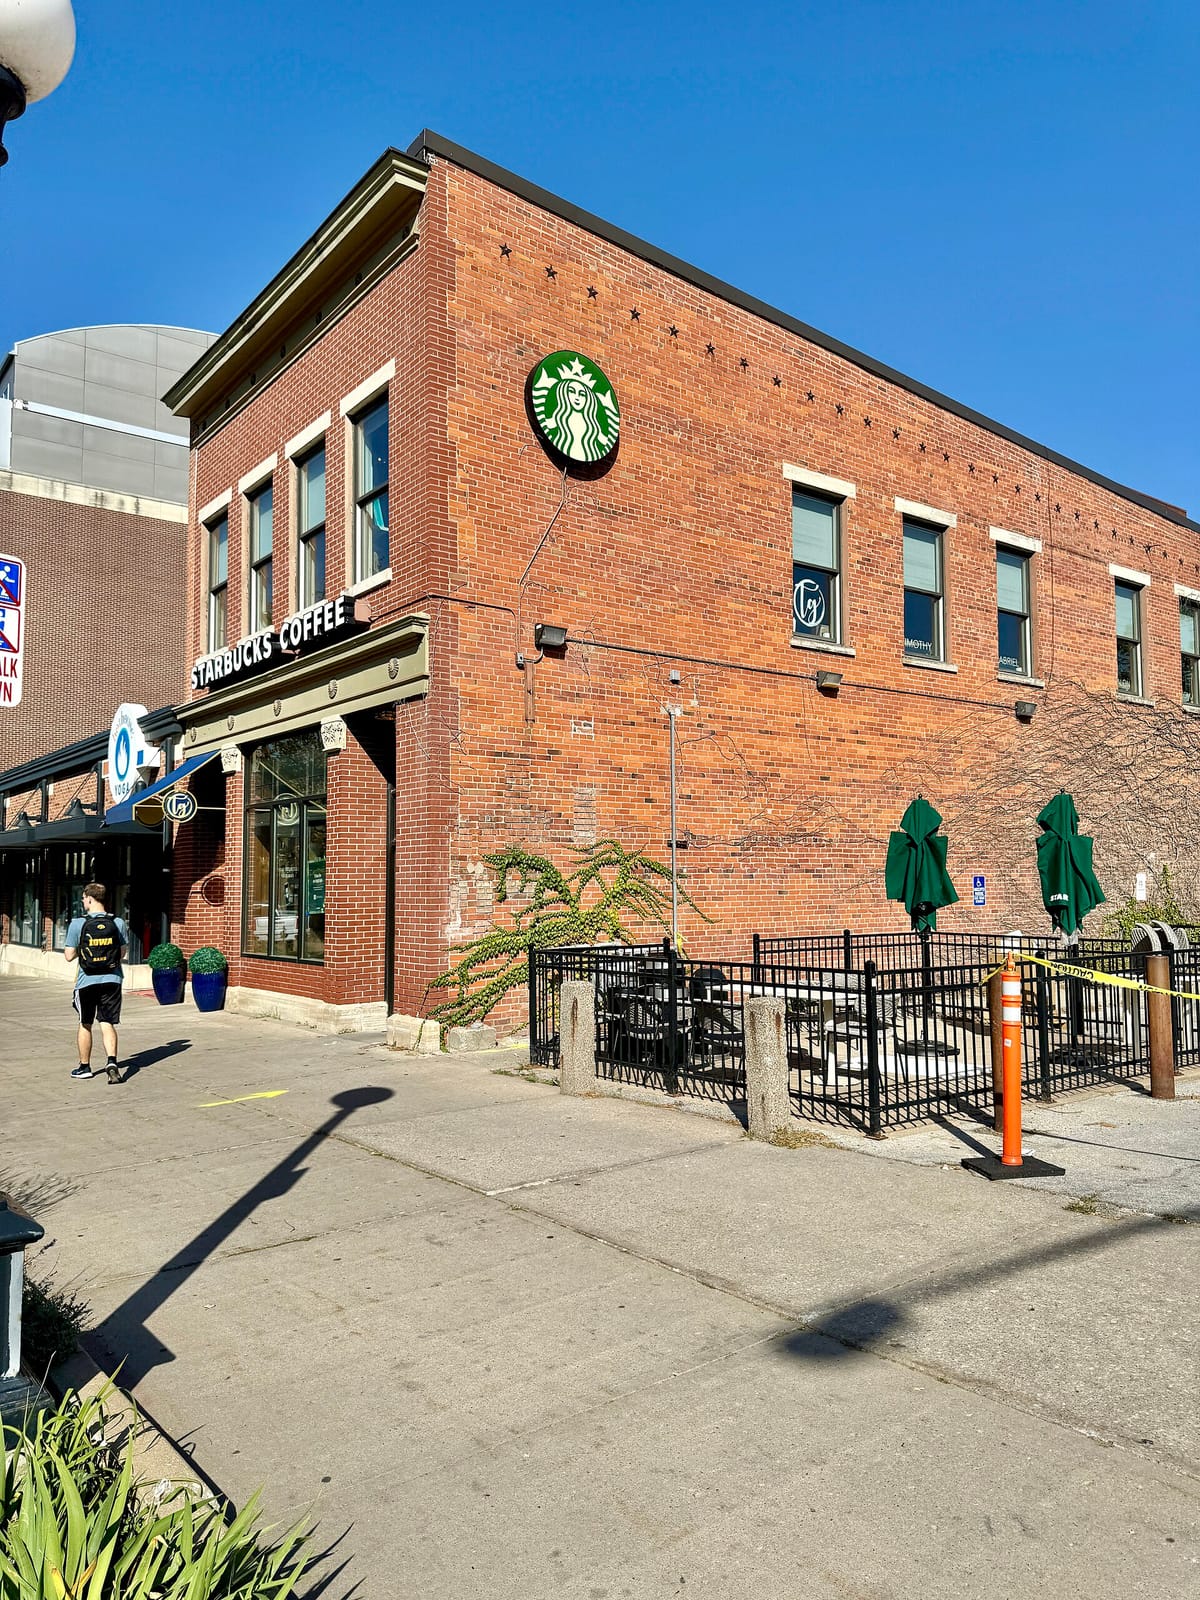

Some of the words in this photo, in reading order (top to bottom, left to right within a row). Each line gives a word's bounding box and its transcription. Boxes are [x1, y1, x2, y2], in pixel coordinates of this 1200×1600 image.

[191, 631, 272, 690] STARBUCKS
[279, 595, 346, 651] COFFEE
[0, 656, 18, 679] LK
[115, 782, 130, 796] YOGA
[88, 937, 113, 947] IOWA
